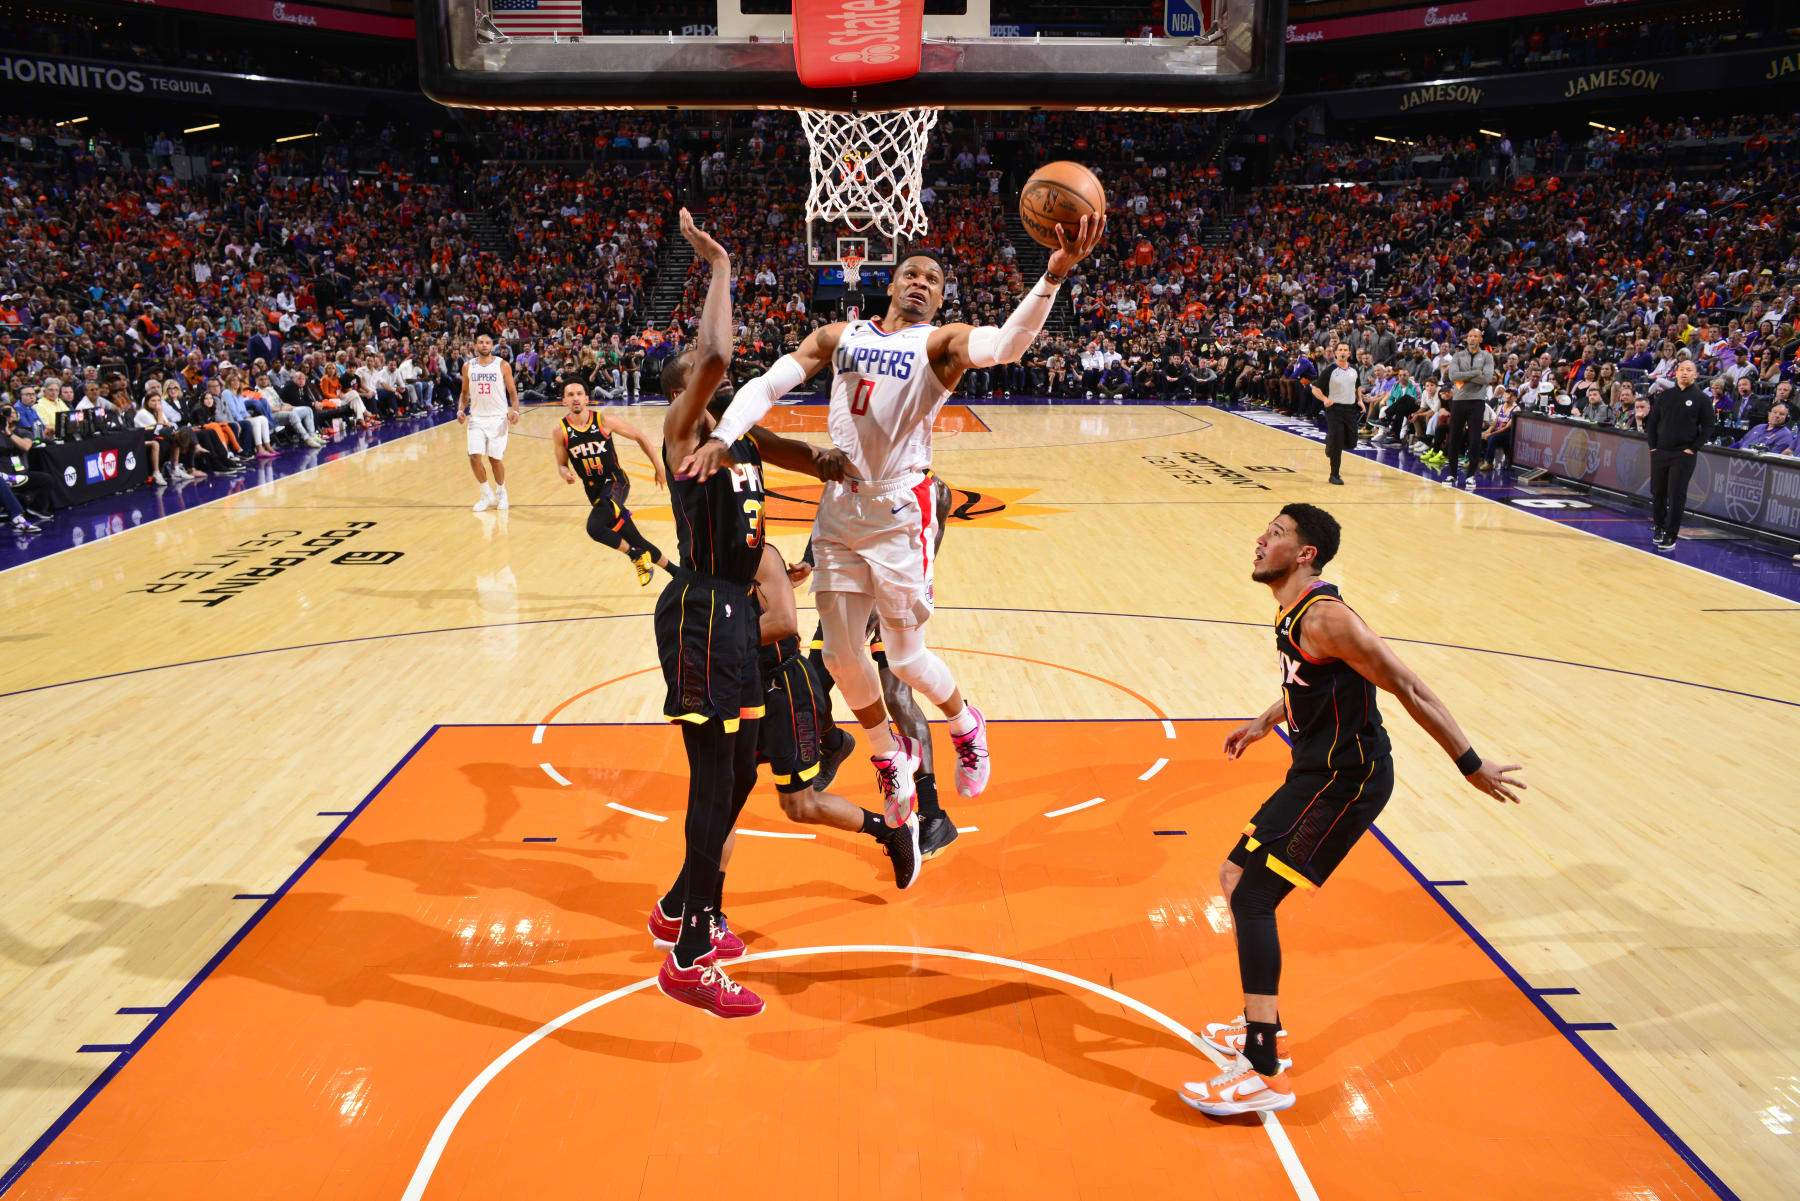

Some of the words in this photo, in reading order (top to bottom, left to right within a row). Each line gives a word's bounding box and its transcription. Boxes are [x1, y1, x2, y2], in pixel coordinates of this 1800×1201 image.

[1171, 13, 1195, 32] NBA
[0, 56, 145, 93] HORNITOS
[150, 77, 213, 95] TEQUILA
[1564, 68, 1662, 98] JAMESON
[1400, 84, 1481, 111] JAMESON
[471, 373, 497, 382] CLIPPERS
[837, 347, 915, 380] CLIPPERS
[478, 383, 491, 394] 33
[850, 379, 876, 416] 0
[569, 440, 607, 458] PHX
[582, 456, 604, 476] 14
[727, 463, 765, 493] PH
[1727, 483, 1762, 502] KINGS
[1770, 470, 1800, 499] TOMO
[126, 530, 303, 594] CENTER
[179, 521, 378, 607] FOOTPRINT
